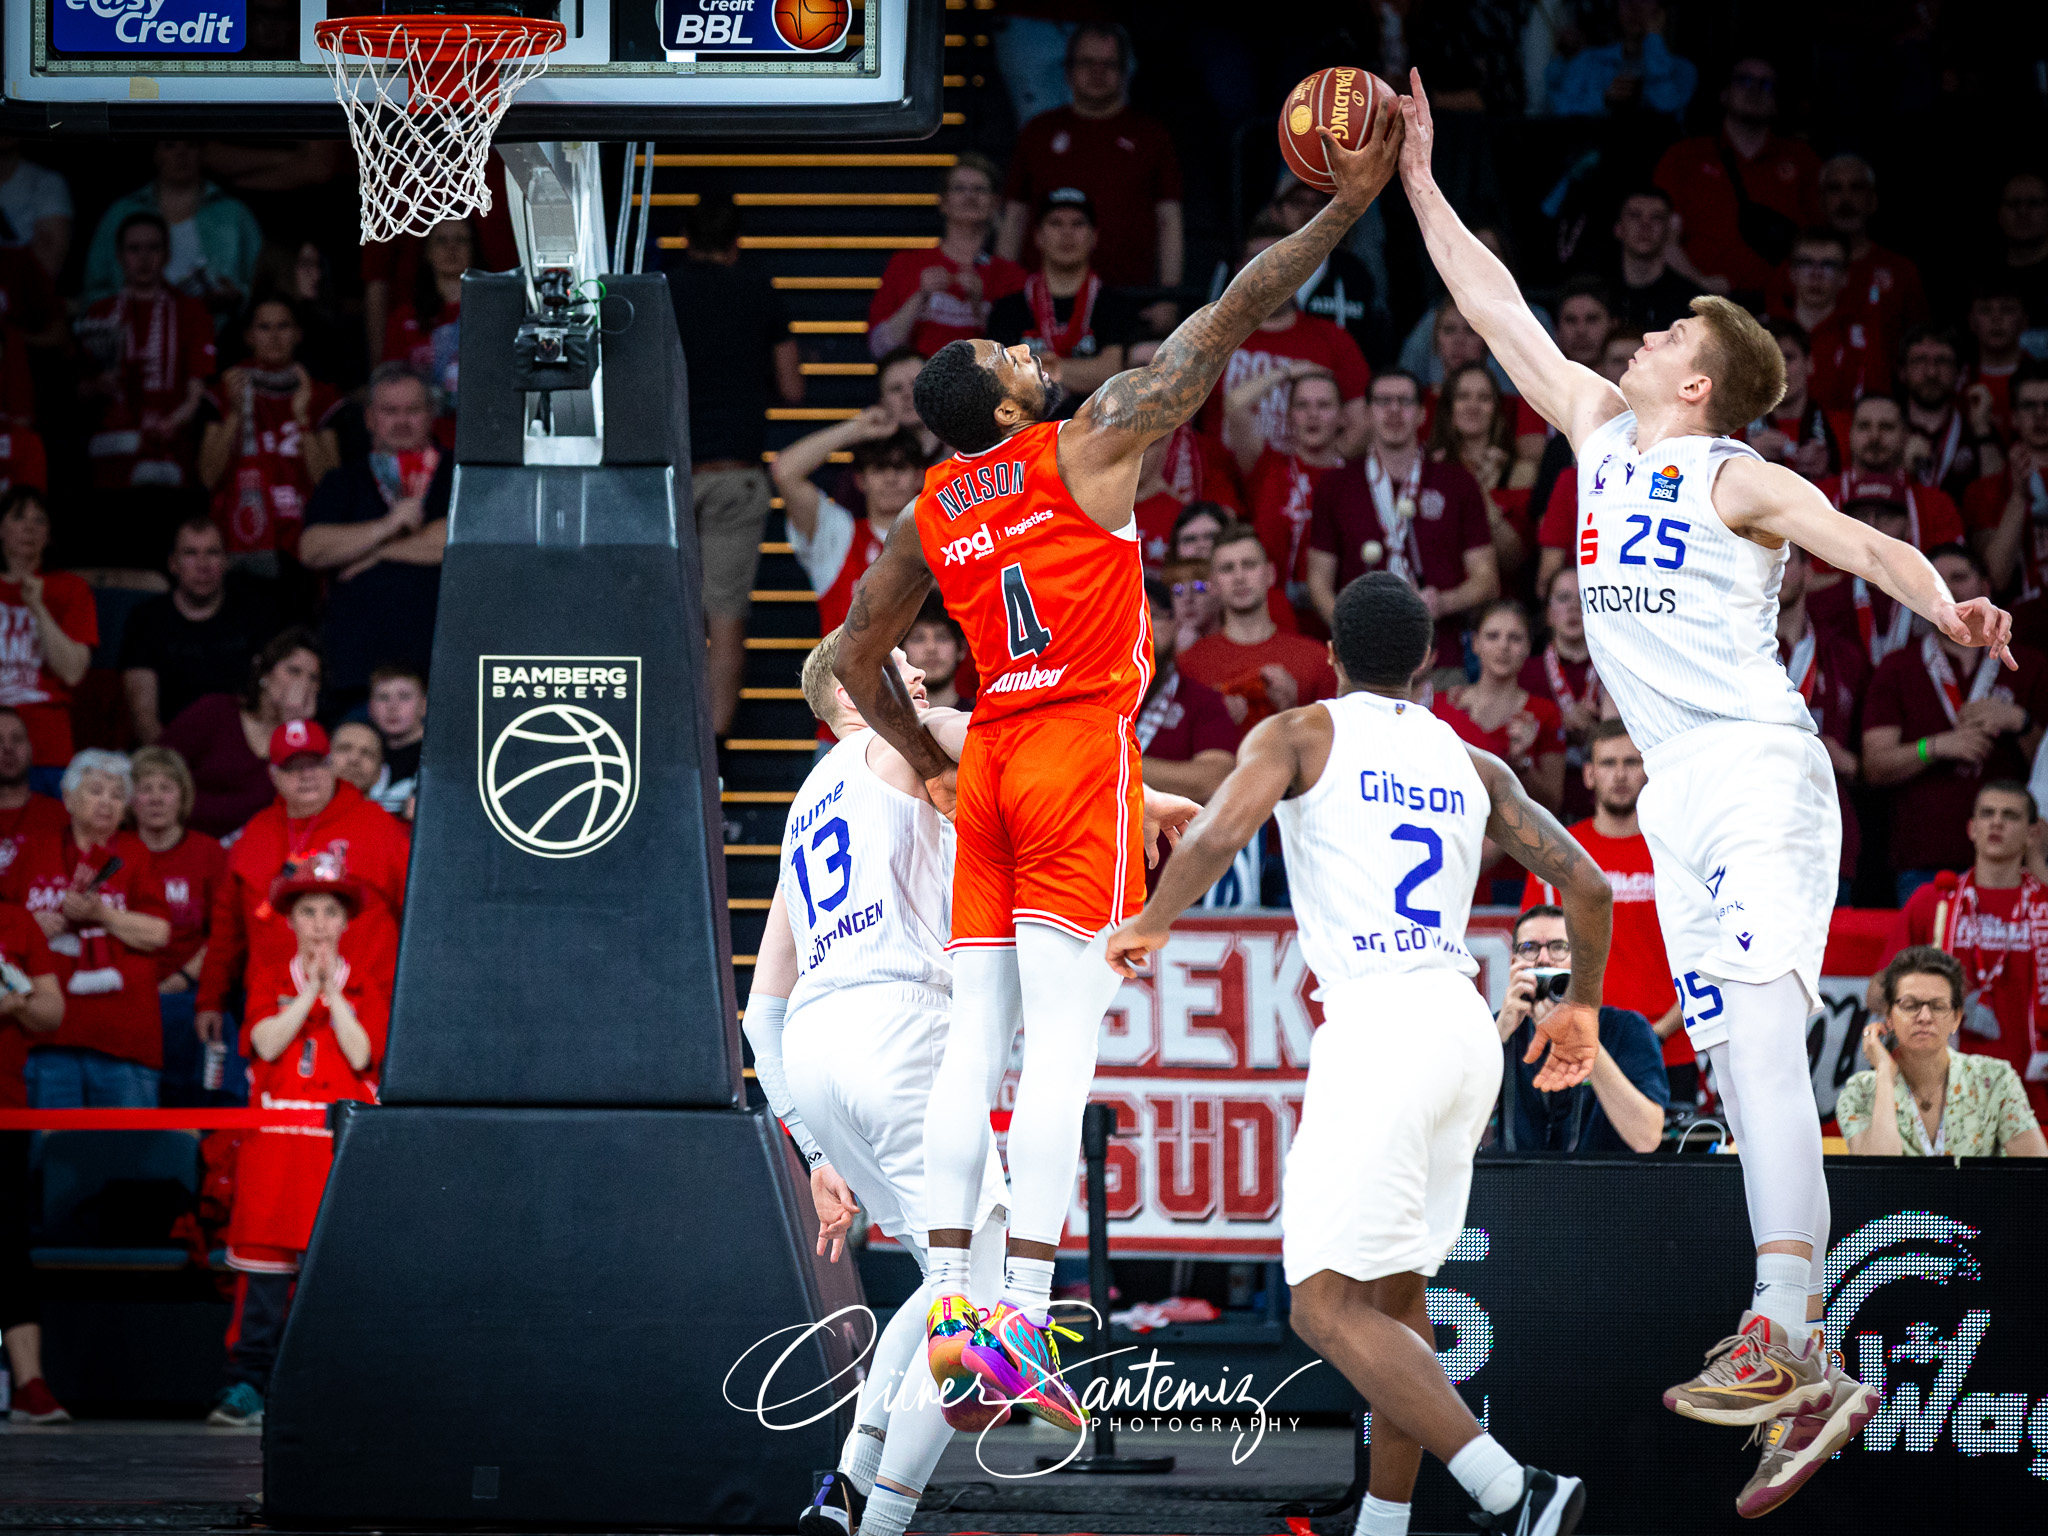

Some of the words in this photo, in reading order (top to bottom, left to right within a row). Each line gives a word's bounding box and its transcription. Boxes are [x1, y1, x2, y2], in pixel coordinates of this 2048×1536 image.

[115, 12, 233, 44] Credit
[675, 14, 753, 45] BBL
[699, 0, 755, 12] Credit
[1329, 68, 1357, 140] SPALDING
[936, 460, 1027, 521] NELSON
[1651, 487, 1676, 501] BBL
[940, 522, 995, 567] xpd
[1004, 509, 1055, 538] logistics
[1619, 513, 1692, 571] 25
[1001, 561, 1053, 661] 4
[1582, 585, 1677, 615] RTORIUS
[492, 666, 628, 685] BAMBERG
[492, 685, 628, 699] BASKETS
[790, 780, 845, 846] Hume
[1360, 770, 1465, 816] Gibson
[791, 816, 852, 930] 13
[1390, 823, 1444, 929] 2
[1673, 970, 1724, 1029] 25
